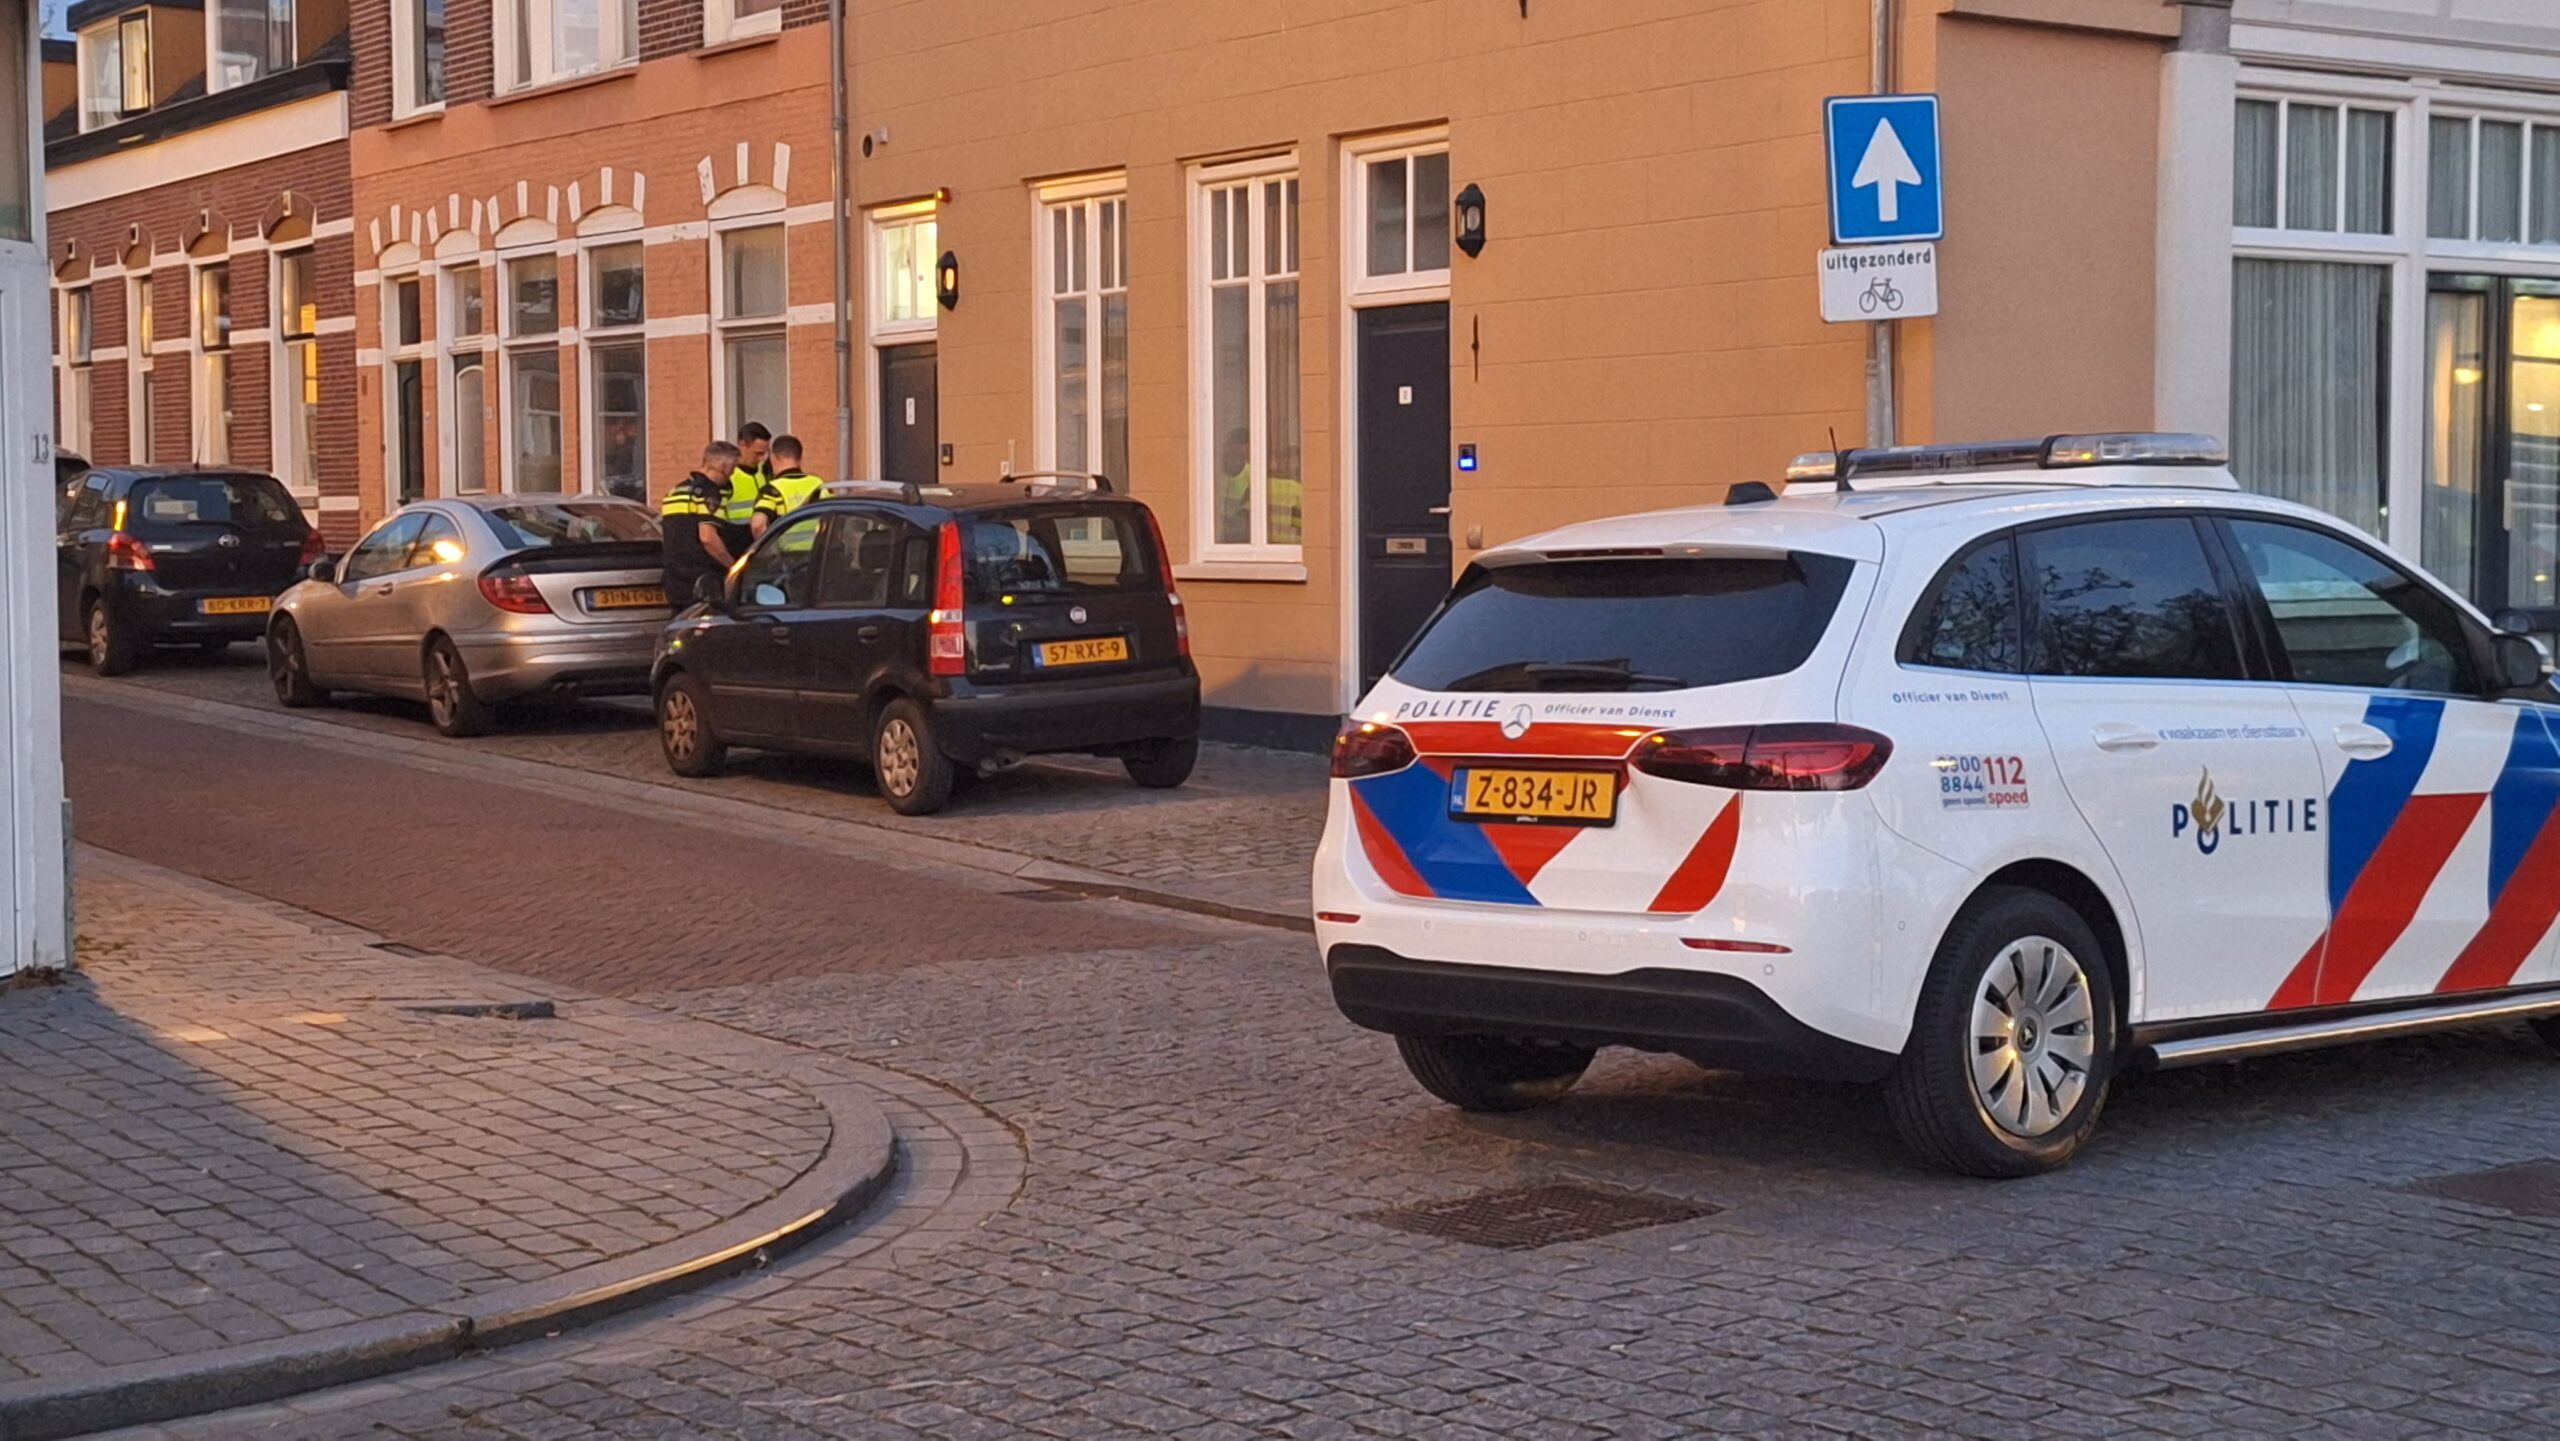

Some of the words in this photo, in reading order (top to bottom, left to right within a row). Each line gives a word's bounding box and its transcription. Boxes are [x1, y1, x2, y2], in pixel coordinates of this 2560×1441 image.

[1826, 248, 1931, 273] uitgezonderd
[33, 433, 49, 460] 13
[1049, 641, 1120, 662] 57-RXF-9
[1892, 691, 1940, 703] Officier
[1945, 693, 1967, 702] van
[1970, 690, 2010, 701] Dienst
[1395, 700, 1500, 718] POLITIE
[1544, 703, 1595, 714] Officier
[1600, 706, 1623, 715] van
[1628, 706, 1676, 718] Dienst
[1983, 756, 2025, 785] 112
[1476, 775, 1596, 812] Z-834-JR
[1941, 776, 1983, 793] 8844
[1988, 788, 2028, 808] spoed
[2172, 799, 2317, 855] POLITIE
